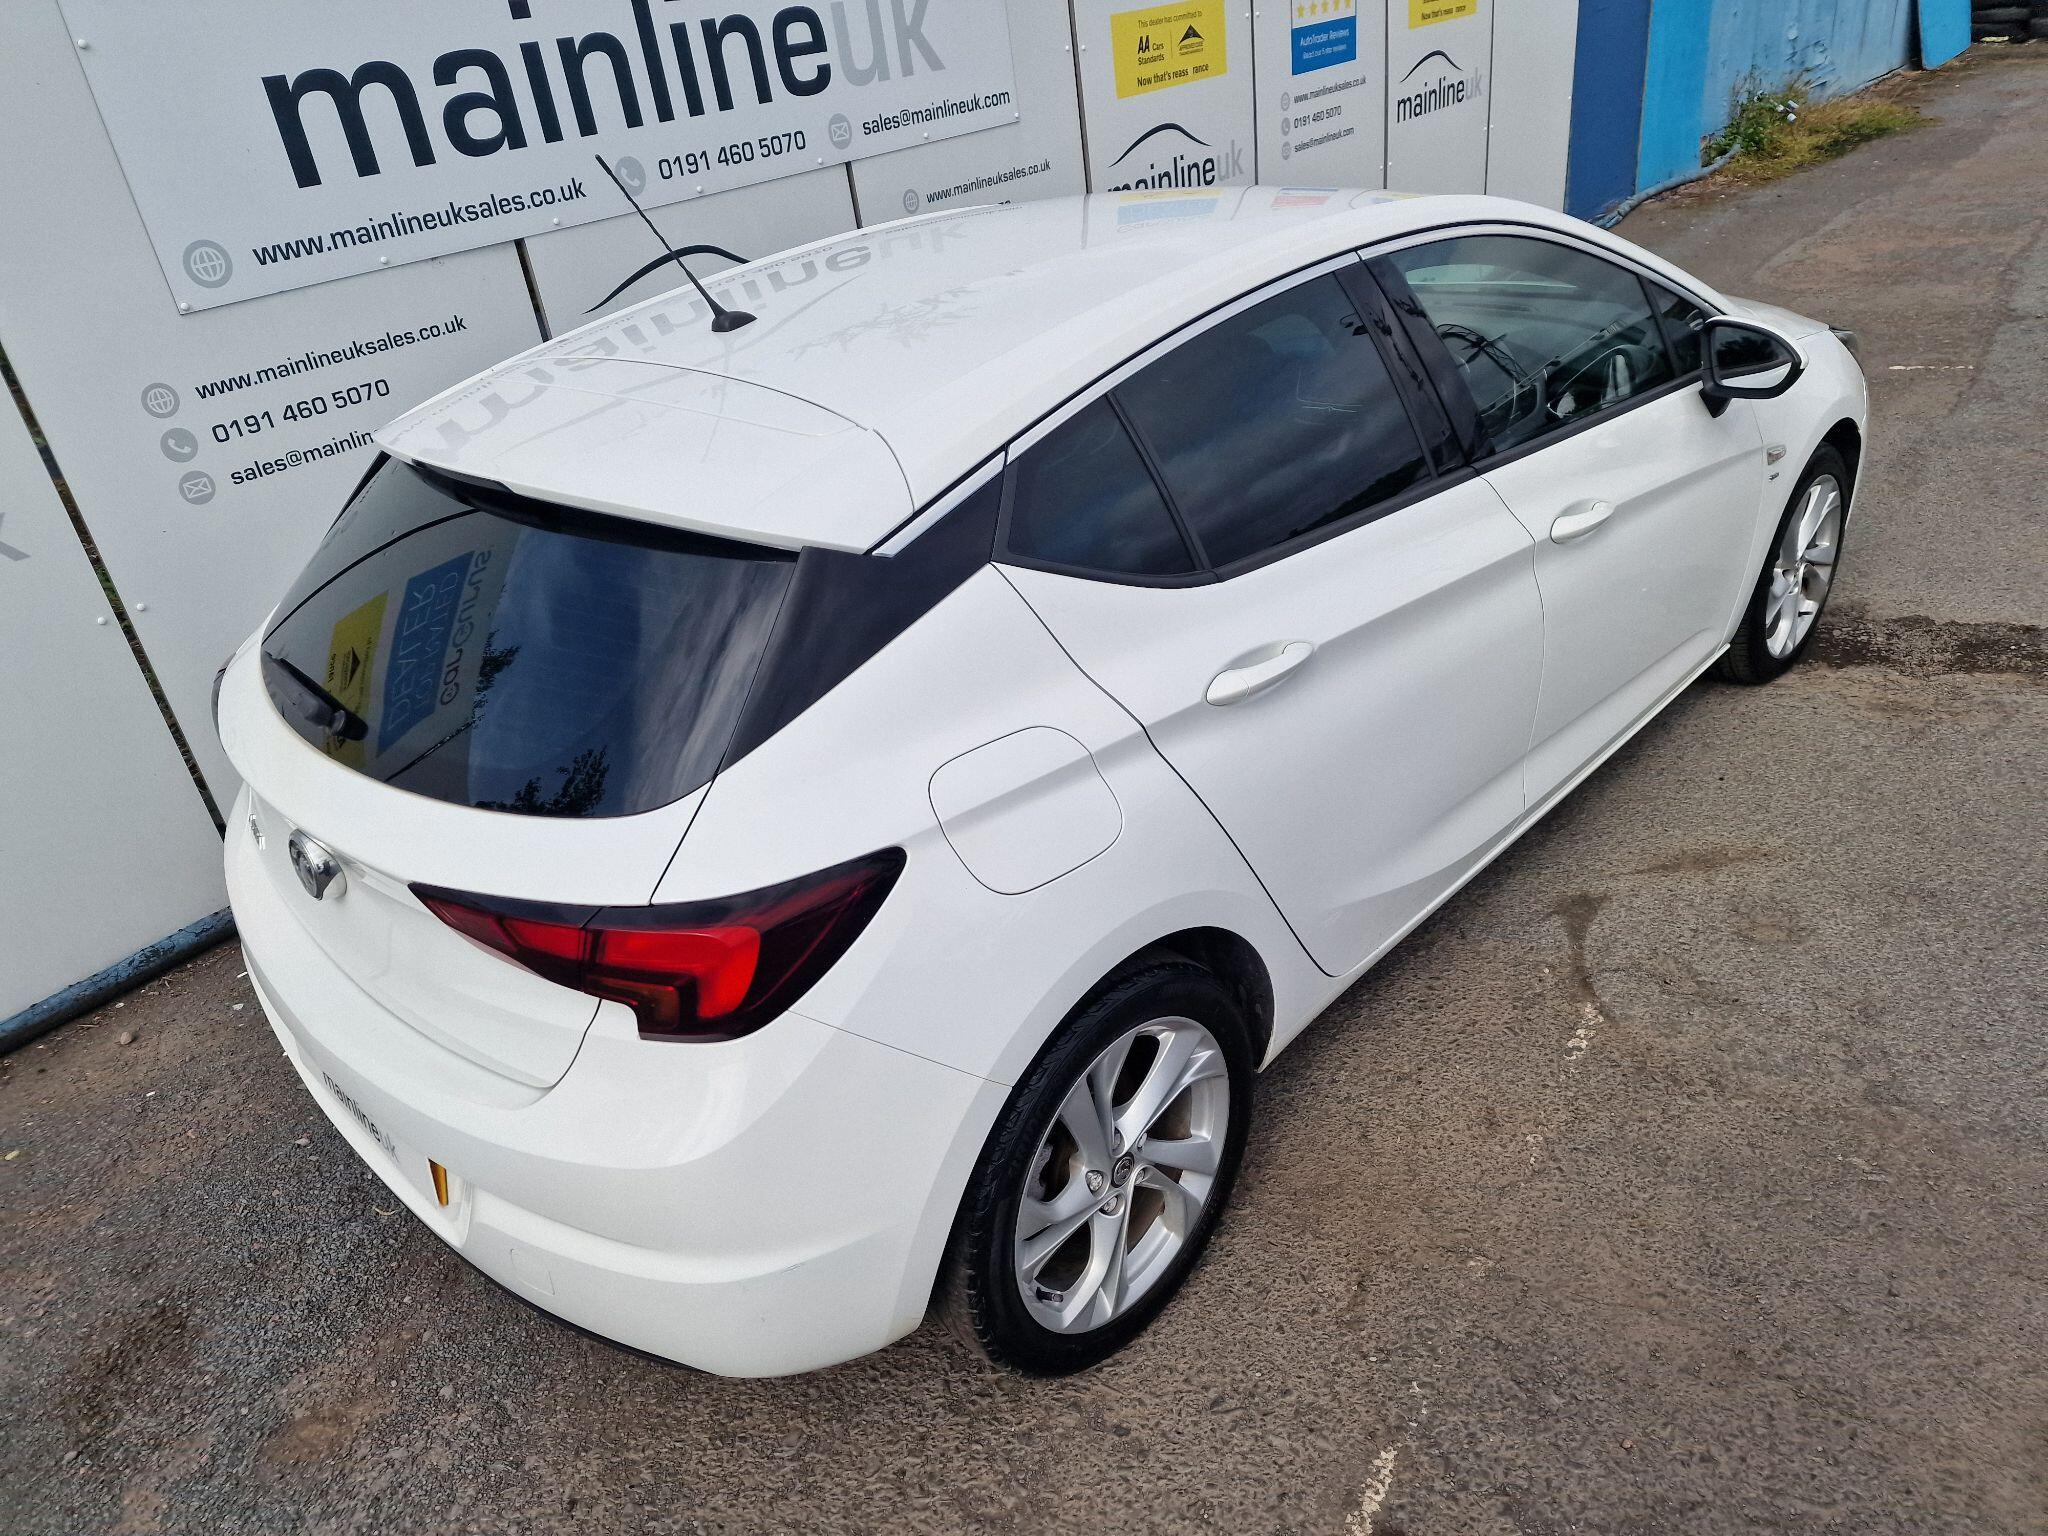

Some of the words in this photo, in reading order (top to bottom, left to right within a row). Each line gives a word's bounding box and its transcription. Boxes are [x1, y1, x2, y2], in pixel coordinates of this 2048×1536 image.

[1138, 34, 1150, 54] AA
[1152, 42, 1165, 51] Cars
[1138, 53, 1165, 65] Standards
[262, 0, 946, 188] mainlineuk
[1137, 77, 1153, 87] Now
[1153, 71, 1172, 83] that's
[1397, 67, 1483, 124] mainlineuk
[863, 89, 1011, 136] sales@mainlineuk.com
[1293, 115, 1311, 129] 0191
[1325, 105, 1342, 119] 5070
[658, 151, 711, 180] 0191
[717, 140, 755, 167] 460
[759, 130, 807, 158] 5070
[925, 158, 1051, 204] www.mainlineuksales.co.uk
[252, 177, 588, 266] www.mainlineuksales.co.uk
[194, 314, 468, 399] www.mainlineuksales.co.uk
[211, 411, 275, 443] 0191
[282, 395, 328, 422] 460
[331, 378, 390, 408] 5070
[230, 429, 379, 485] sales@mainlin
[322, 1071, 400, 1163] mainlineuk
